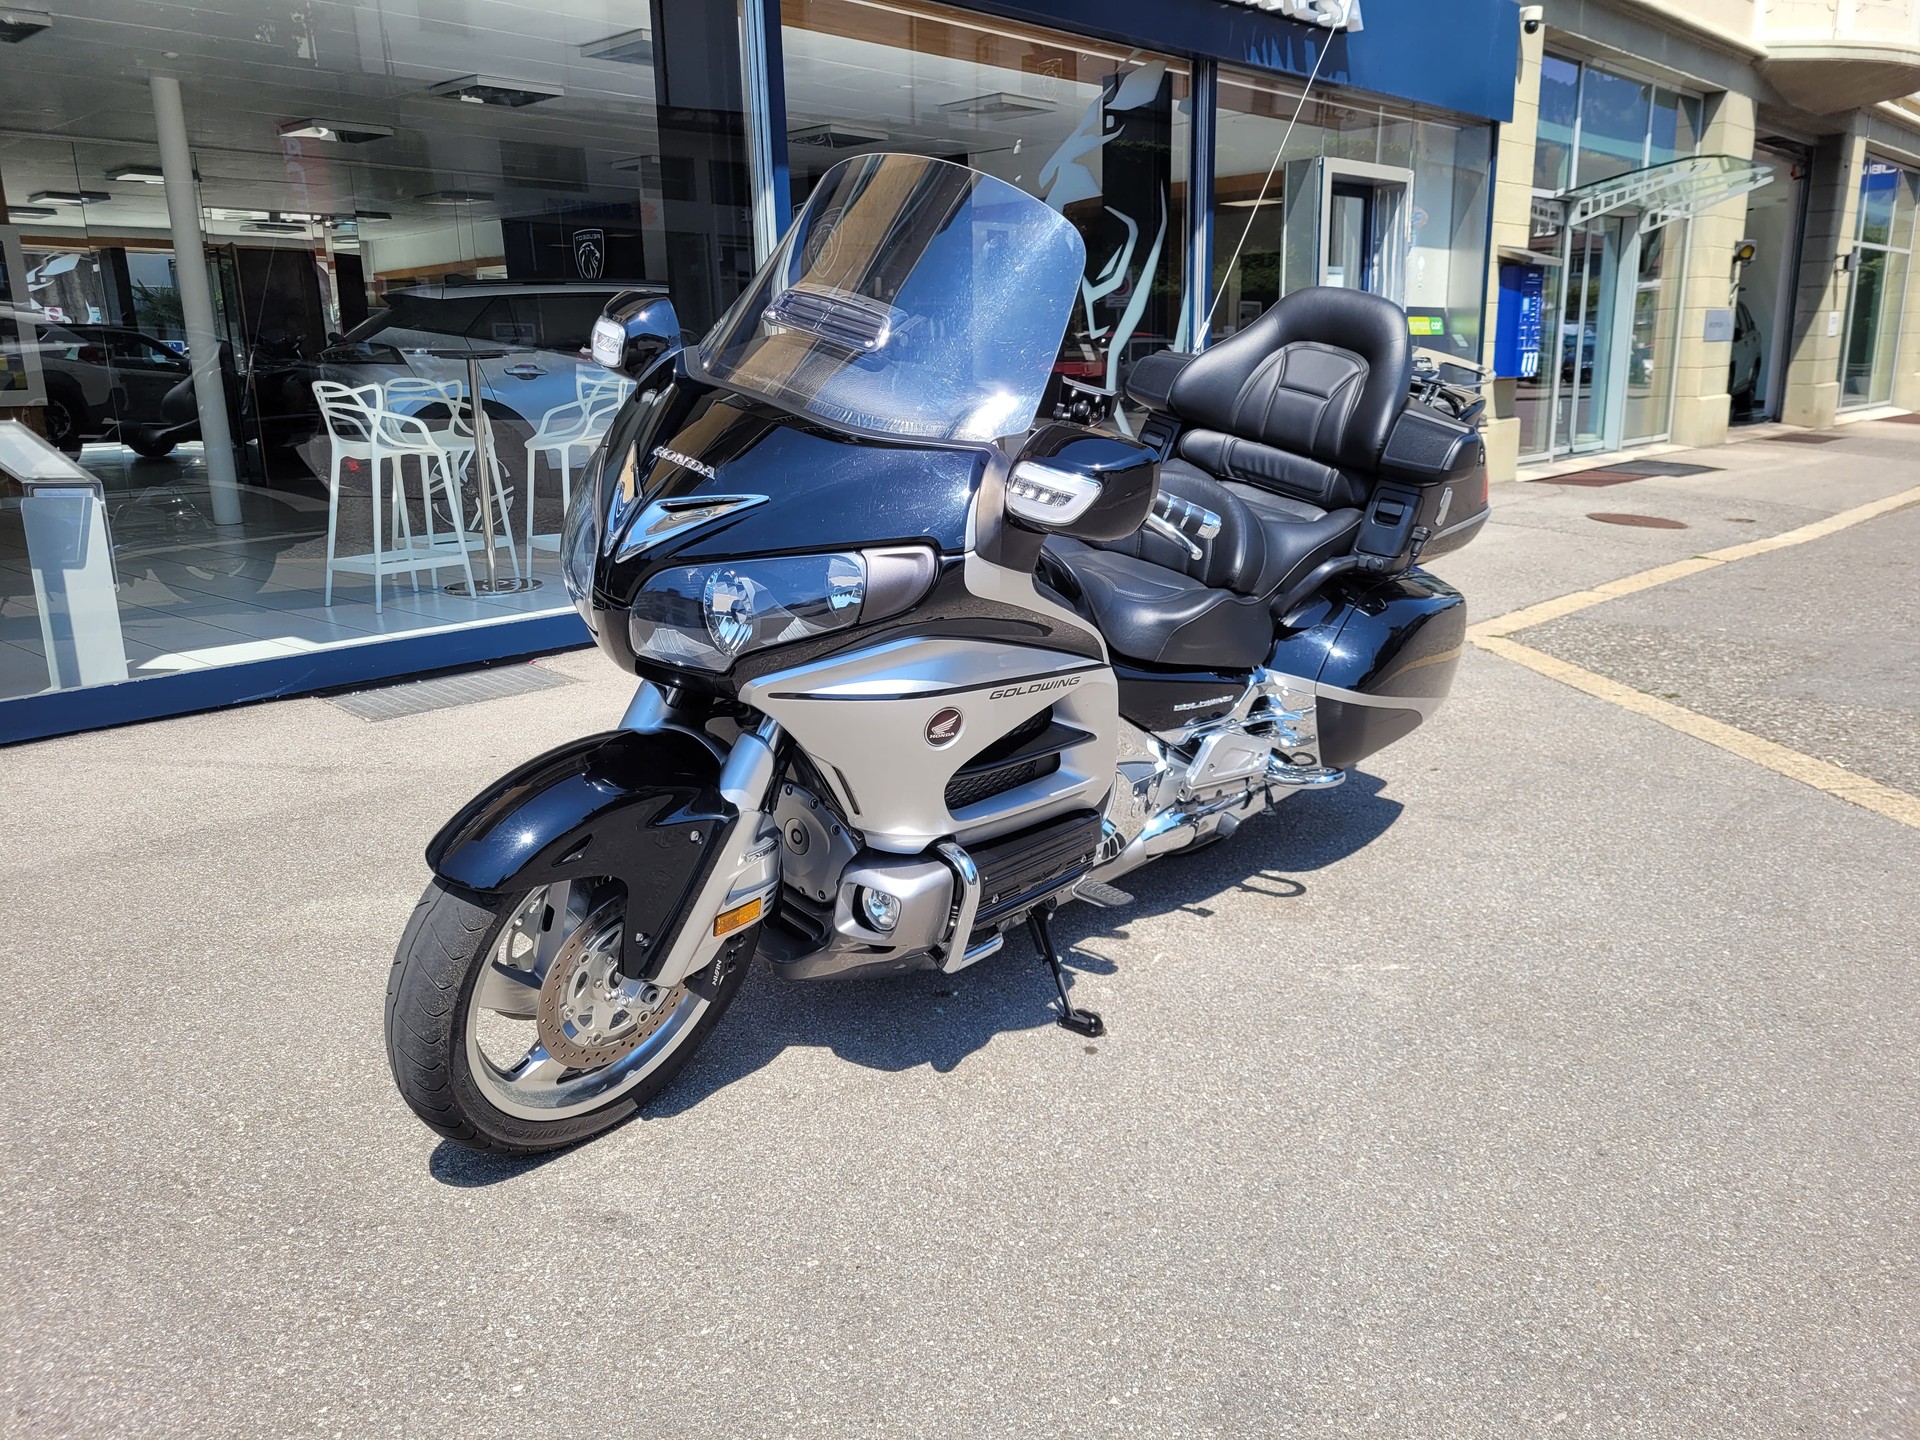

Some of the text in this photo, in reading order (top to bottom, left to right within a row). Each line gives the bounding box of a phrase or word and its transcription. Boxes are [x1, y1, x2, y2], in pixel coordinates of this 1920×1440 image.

[652, 445, 716, 480] HONDA
[989, 676, 1081, 700] GOLDWING
[1173, 694, 1234, 711] GOLDWING
